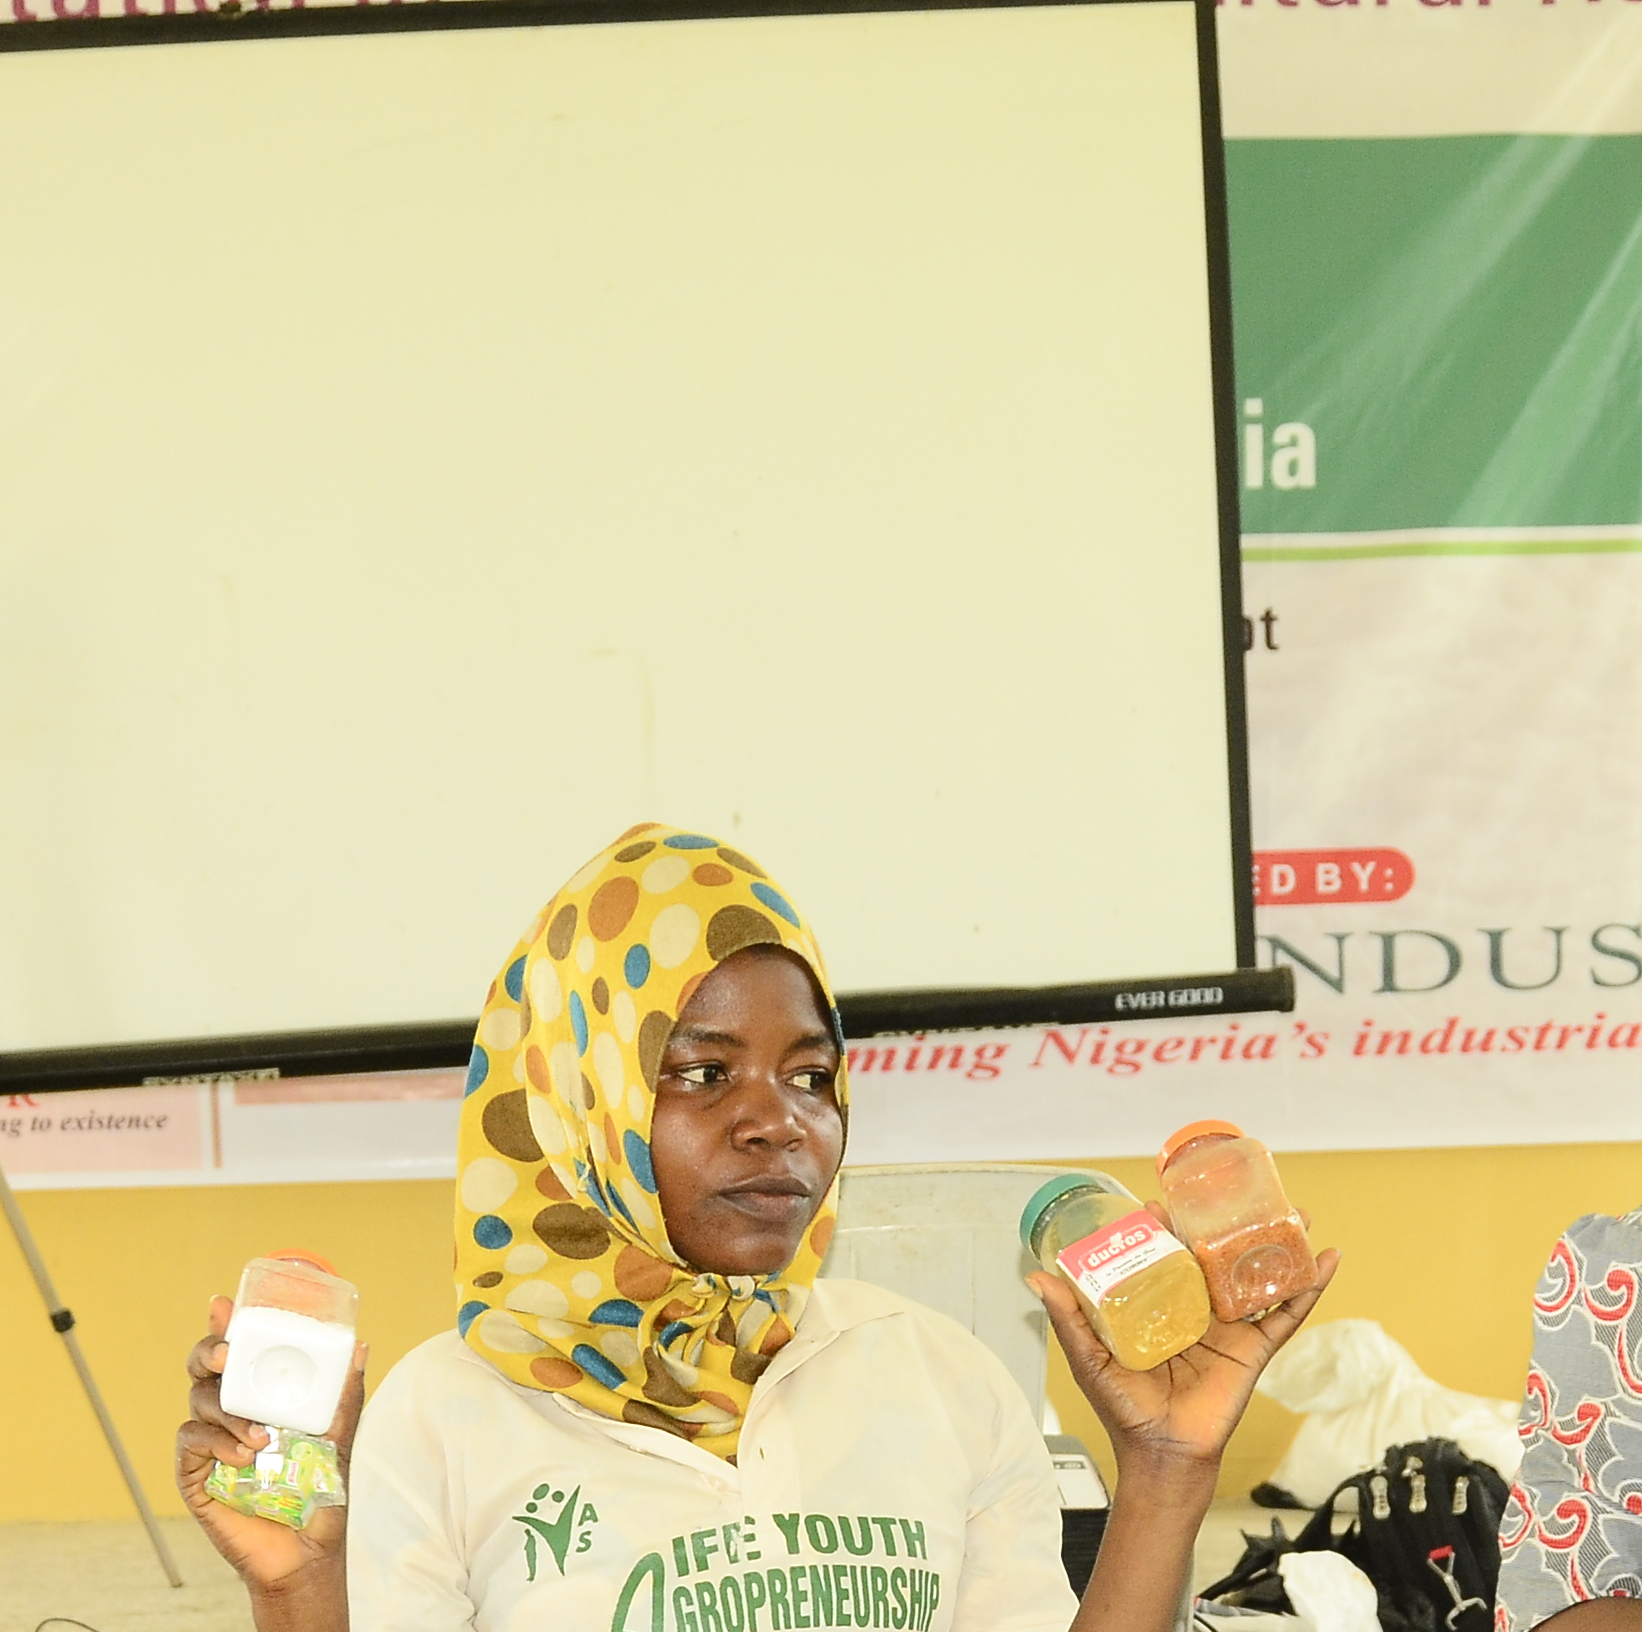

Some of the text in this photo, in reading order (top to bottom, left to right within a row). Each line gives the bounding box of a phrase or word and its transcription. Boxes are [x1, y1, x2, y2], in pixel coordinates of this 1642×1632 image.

[1315, 861, 1396, 893] BY:
[1115, 986, 1224, 1011] EVER GOOD
[31, 1114, 54, 1132] to
[60, 1110, 168, 1132] existence
[773, 1511, 928, 1561] YOUTH
